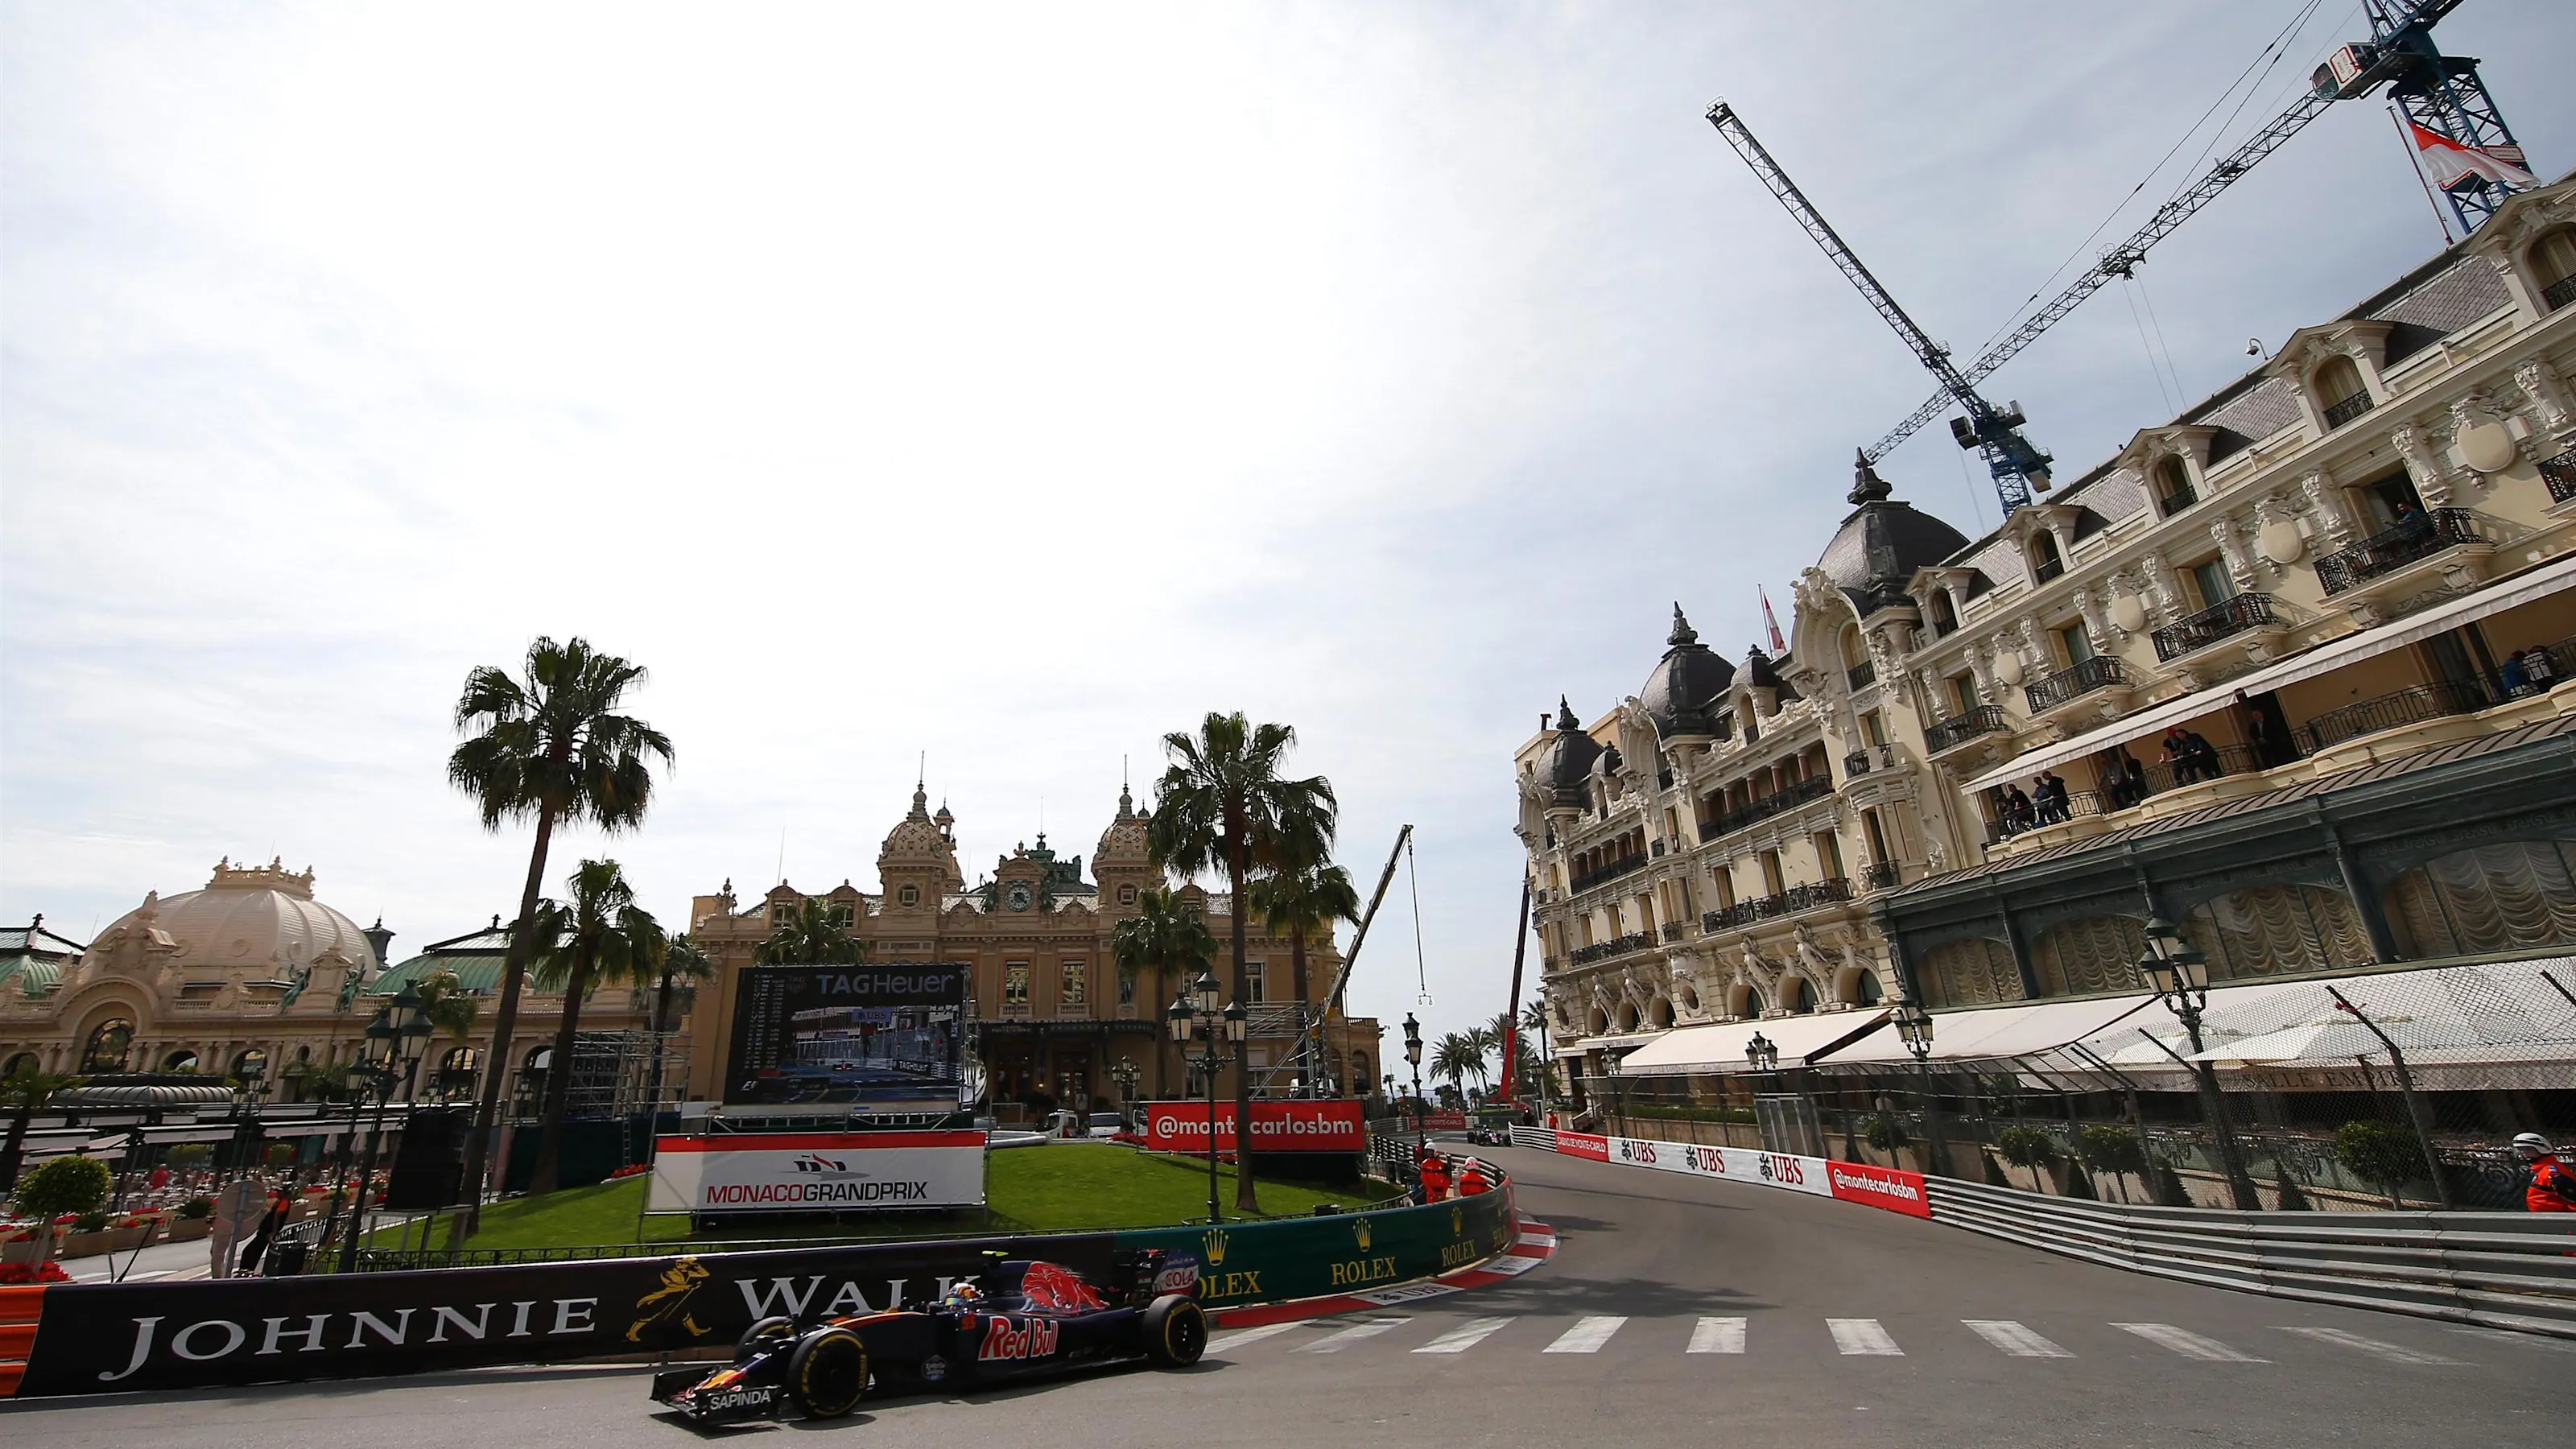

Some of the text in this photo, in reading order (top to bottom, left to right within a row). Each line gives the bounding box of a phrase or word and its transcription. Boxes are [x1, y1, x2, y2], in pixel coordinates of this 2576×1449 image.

[2245, 1071, 2310, 1088] SALLE
[1156, 1113, 1353, 1139] @montcarlosbm
[1631, 1141, 1657, 1163] UBS
[1696, 1147, 1725, 1173] UBS
[1771, 1154, 1804, 1185] UBS
[1833, 1167, 1919, 1202] @montecarlosbm
[1441, 1240, 1476, 1267] ROLEX
[1166, 1270, 1195, 1286] COLA
[1331, 1256, 1397, 1286] ROLEX
[1199, 1271, 1262, 1299] LEX
[98, 1298, 598, 1381] JOHNNIE
[978, 1315, 1059, 1360] Red Bull
[710, 1389, 771, 1411] SAPINDA
